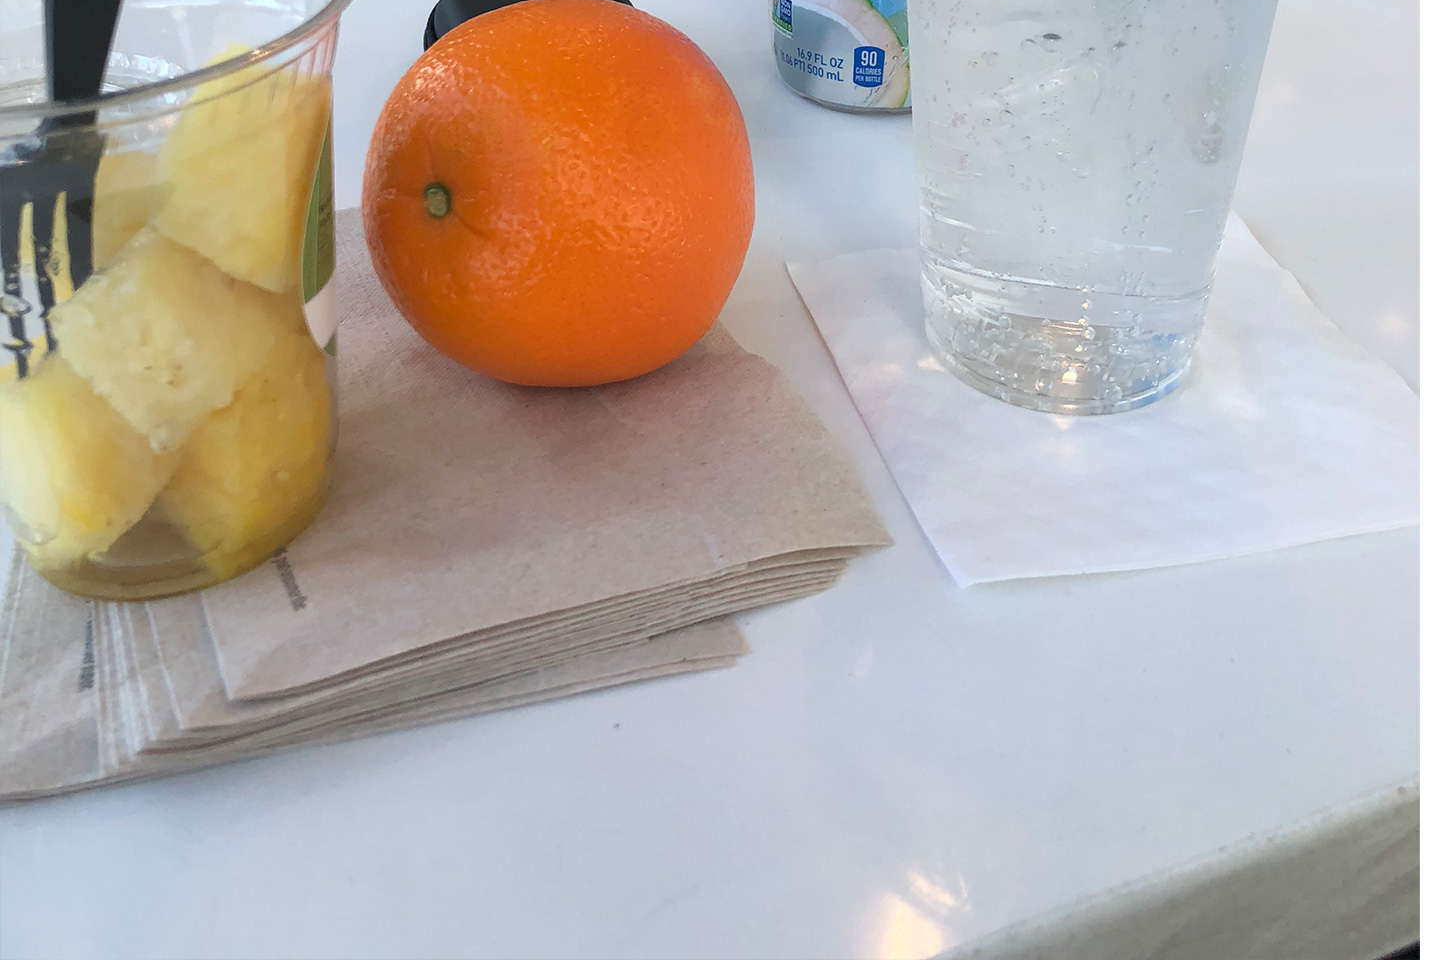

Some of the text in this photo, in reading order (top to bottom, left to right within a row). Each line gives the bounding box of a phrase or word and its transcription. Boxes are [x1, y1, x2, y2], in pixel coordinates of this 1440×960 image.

[797, 47, 845, 69] 16.9 FL OZ
[861, 50, 878, 67] 90
[807, 63, 824, 78] 500
[826, 70, 844, 82] mL
[855, 67, 881, 76] CALORIES
